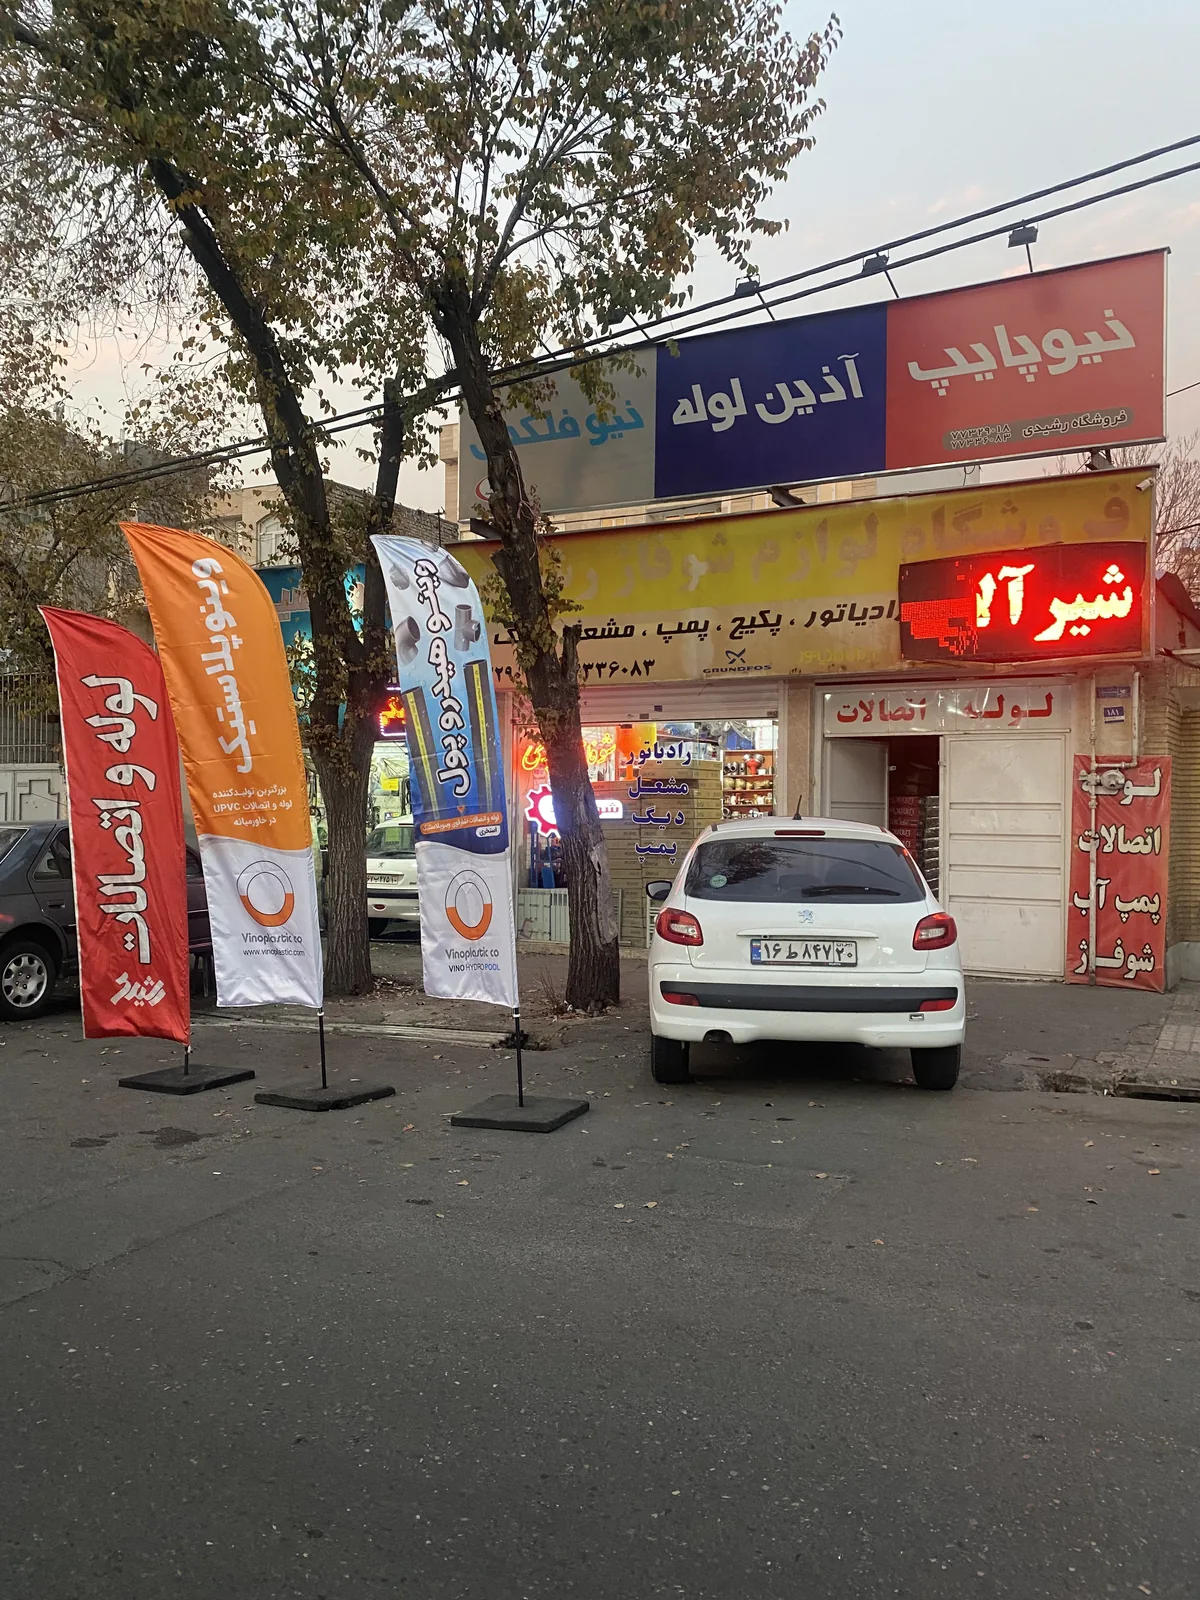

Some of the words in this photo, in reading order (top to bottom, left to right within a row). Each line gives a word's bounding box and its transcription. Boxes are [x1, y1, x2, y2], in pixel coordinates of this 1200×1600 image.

[754, 352, 864, 424] آذین
[672, 377, 748, 433] لوله
[1022, 417, 1069, 438] رشیدی
[1071, 409, 1128, 428] فروشگاه
[950, 423, 1012, 440] ۷۷۳۲۹۰۱۸
[950, 432, 1012, 449] ۷۷۳۳۶۰۸۳
[804, 600, 900, 628] ادیاتور
[1034, 564, 1133, 641] شیر
[656, 619, 710, 644] پمپ
[702, 664, 773, 674] GRUNDFOS
[80, 673, 159, 755] لوله
[836, 697, 927, 724] اتصالات
[625, 739, 692, 766] رادیاتور
[103, 762, 156, 793] و
[628, 775, 689, 799] مشعل
[256, 784, 287, 798] بزرگترین
[213, 802, 241, 813] UPVC
[242, 800, 271, 811] اتصالات
[271, 802, 278, 811] و
[278, 799, 293, 811] لوله
[233, 816, 267, 827] خاورمیانه
[268, 816, 277, 827] در
[1078, 823, 1162, 856] اتصالات
[635, 841, 677, 865] پمپ
[90, 797, 152, 966] اتصالات
[1073, 877, 1111, 917] آب
[1114, 892, 1161, 925] پمپ
[241, 932, 293, 945] Vinoplastic
[445, 946, 488, 961] Vinoplastic
[489, 949, 500, 958] co
[764, 943, 782, 959] ۱۶
[785, 943, 798, 960] ط
[802, 943, 832, 961] ۸۴۷
[835, 947, 853, 962] ۲۰
[1073, 937, 1155, 979] شوفژ
[448, 964, 465, 973] VINO
[110, 971, 167, 1007] رشیدی
